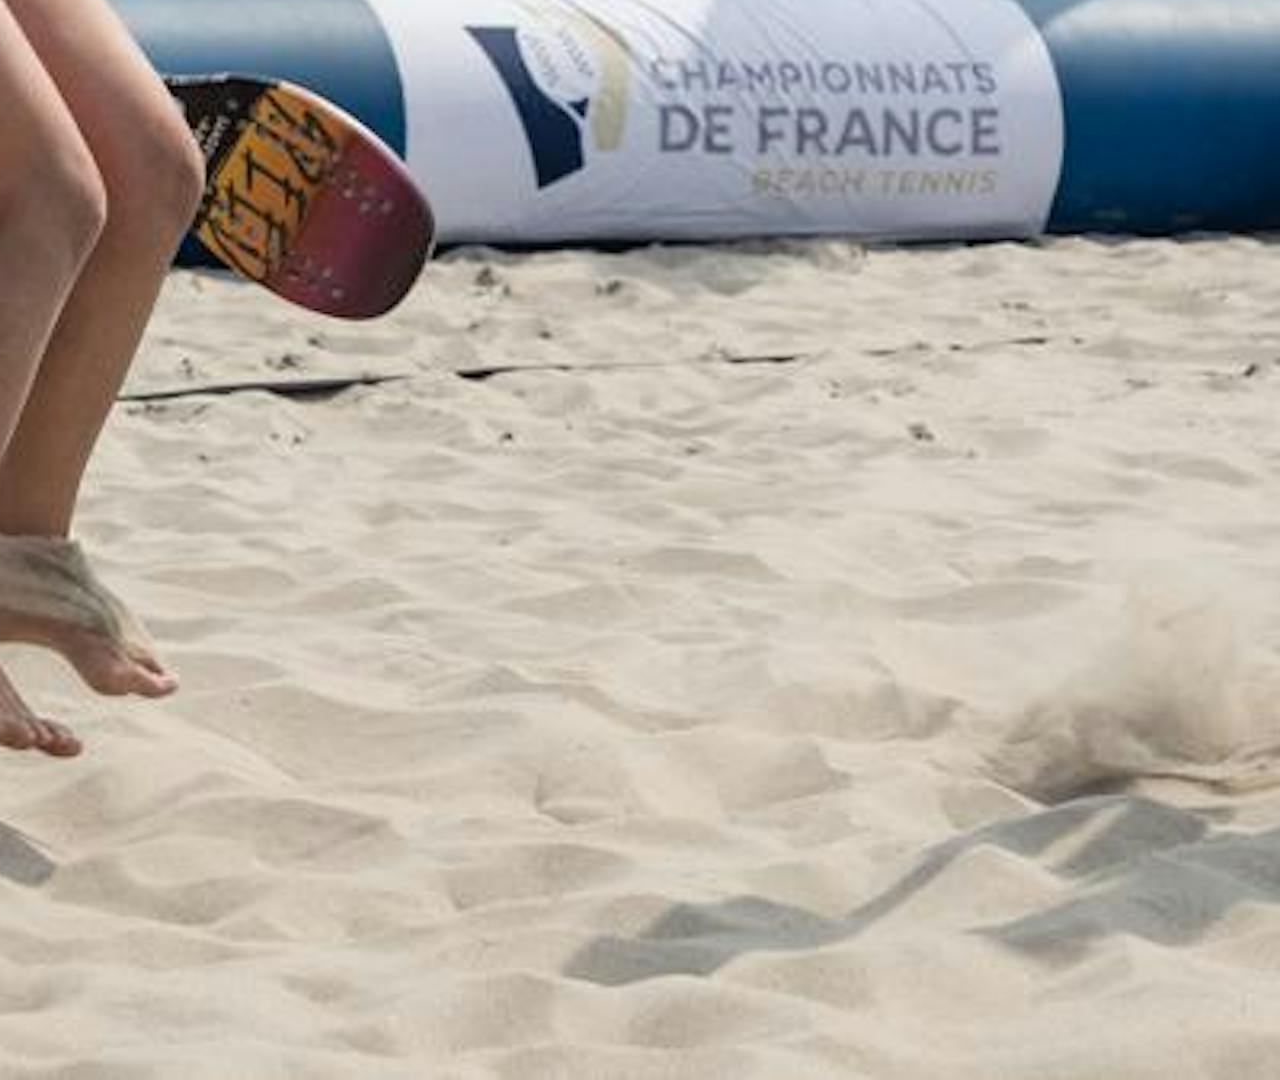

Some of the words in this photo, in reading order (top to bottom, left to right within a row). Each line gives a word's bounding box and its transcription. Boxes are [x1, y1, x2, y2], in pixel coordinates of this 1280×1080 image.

[652, 59, 998, 95] CHAMPIONNATS
[659, 105, 734, 155] DE
[756, 107, 1001, 157] FRANCE
[751, 169, 866, 197] BEACH
[879, 168, 998, 196] TENNIS
